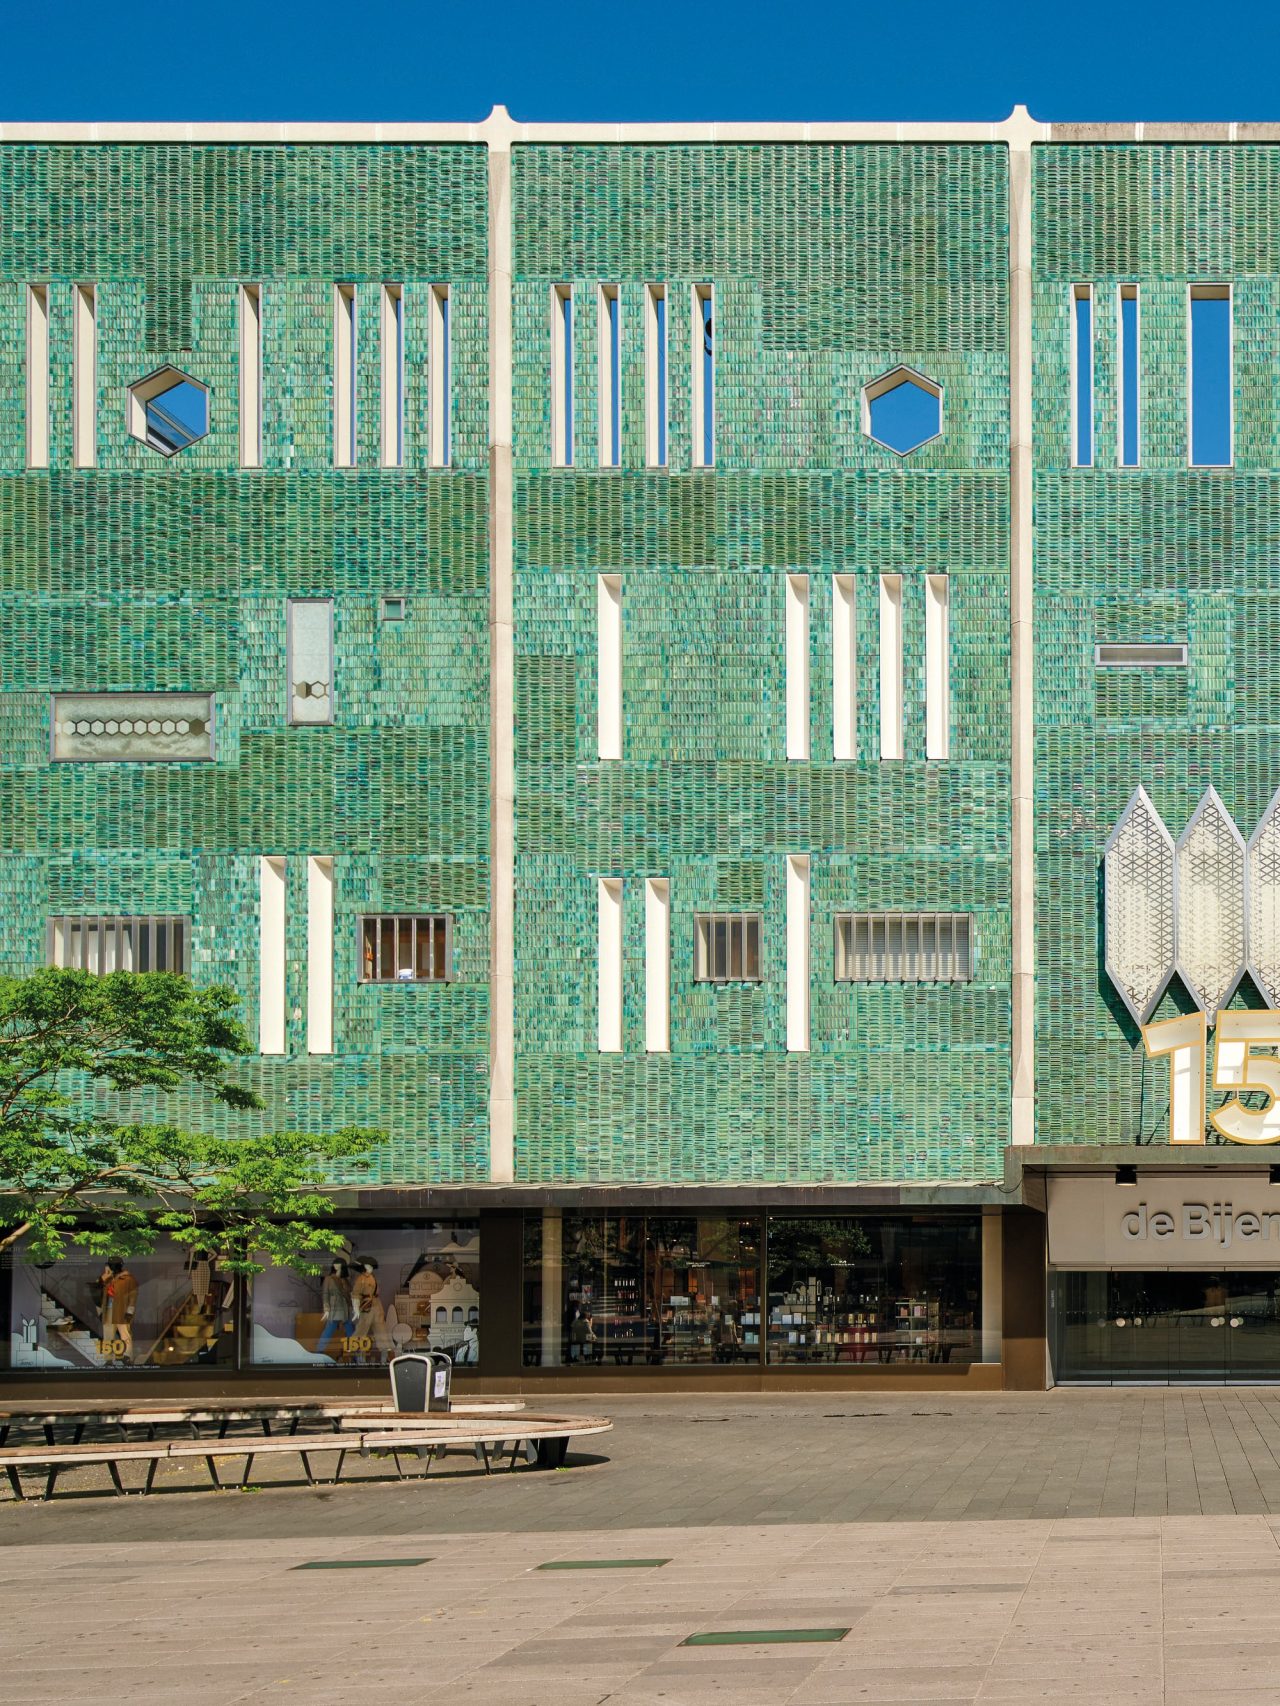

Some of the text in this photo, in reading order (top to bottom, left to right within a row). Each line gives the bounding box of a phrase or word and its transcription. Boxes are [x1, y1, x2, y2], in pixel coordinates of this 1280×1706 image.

[1121, 1202, 1175, 1241] de
[95, 1339, 125, 1356] 150
[340, 1335, 372, 1353] 150
